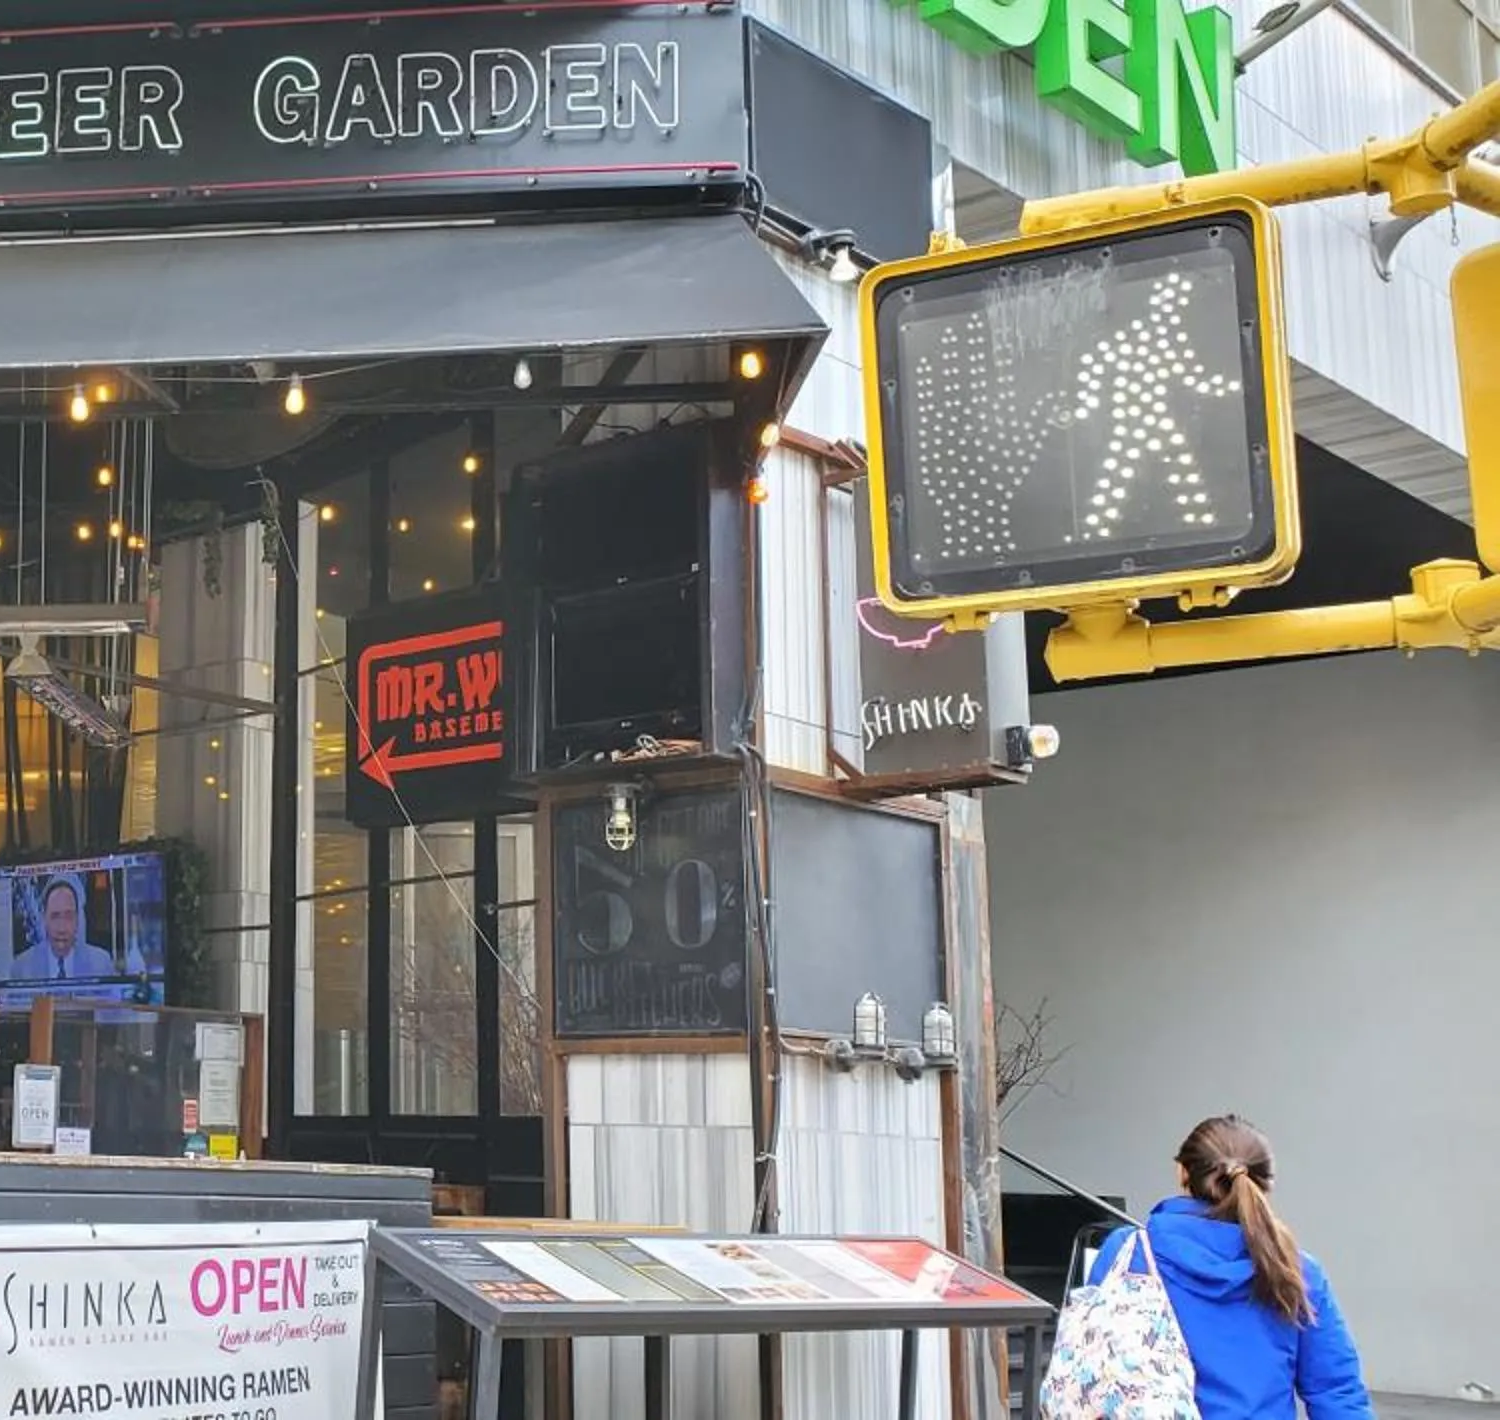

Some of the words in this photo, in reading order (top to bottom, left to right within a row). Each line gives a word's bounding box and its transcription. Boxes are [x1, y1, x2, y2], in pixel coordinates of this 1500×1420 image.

[254, 42, 680, 144] GARDEN
[861, 693, 983, 751] SHINKA
[21, 1106, 50, 1119] OPEN
[190, 1256, 307, 1317] OPEN
[314, 1256, 339, 1271] TAKE
[339, 1255, 359, 1270] OUT
[3, 1272, 168, 1356] SHINKA
[313, 1291, 359, 1308] DELIVERY
[9, 1374, 237, 1417] AWARD-WINNING
[243, 1366, 312, 1400] RAMEN
